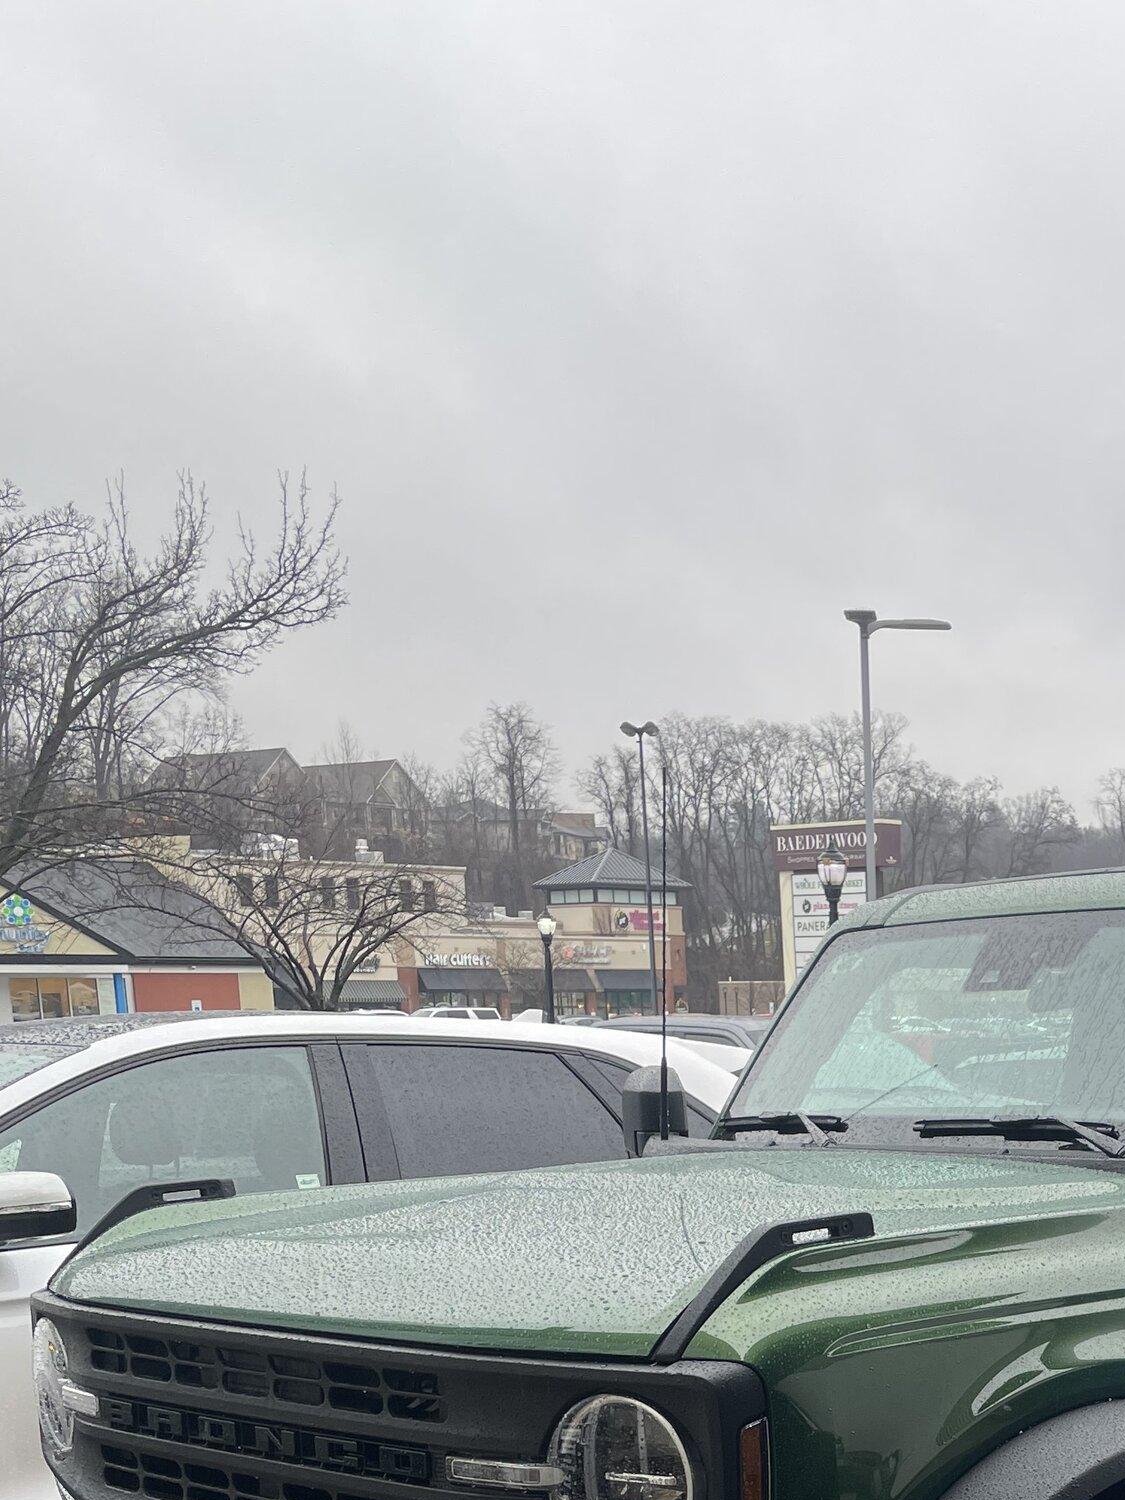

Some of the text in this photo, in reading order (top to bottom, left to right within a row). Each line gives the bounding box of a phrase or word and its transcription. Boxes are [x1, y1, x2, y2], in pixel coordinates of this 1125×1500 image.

[776, 831, 878, 852] BAEDEWOO
[813, 902, 830, 912] plan
[100, 1397, 426, 1477] BRONCO
